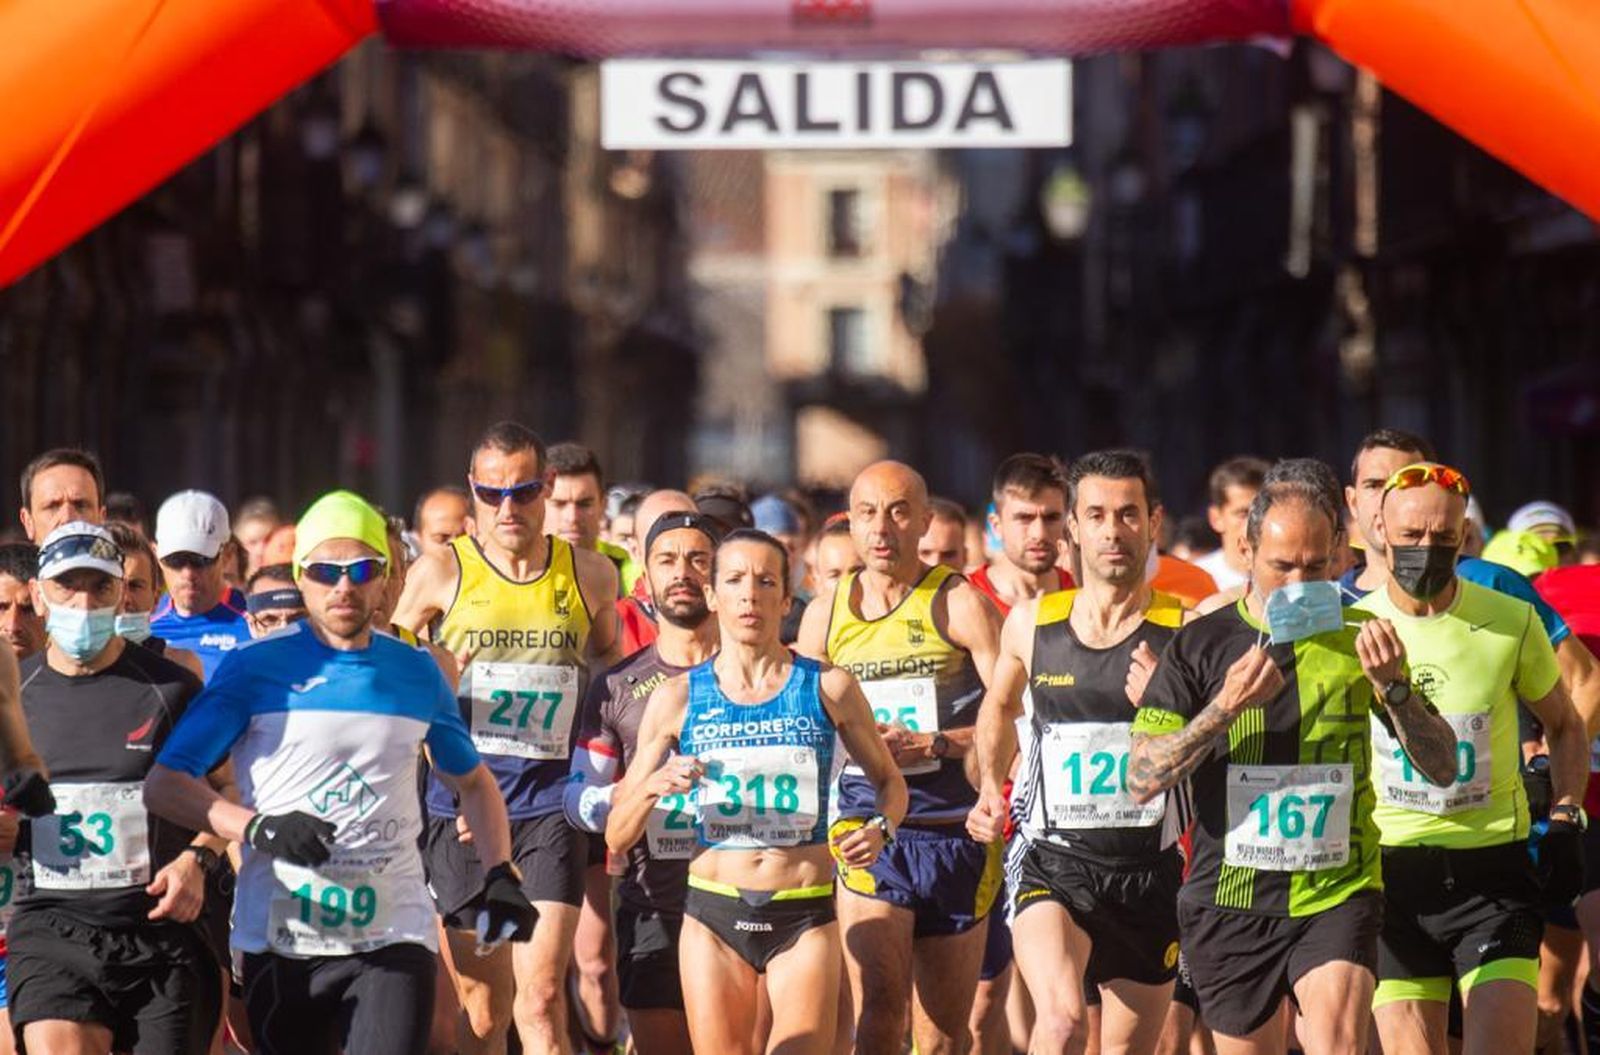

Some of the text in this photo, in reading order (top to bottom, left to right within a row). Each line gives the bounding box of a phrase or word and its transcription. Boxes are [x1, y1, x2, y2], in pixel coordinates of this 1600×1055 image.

[655, 71, 1016, 134] SALIDA
[465, 625, 578, 650] TORREJÓN
[489, 689, 563, 730] 277
[692, 716, 821, 741] CORPOREPOL
[1392, 740, 1476, 783] 10
[717, 774, 800, 817] 318
[1249, 793, 1337, 840] 167
[59, 810, 115, 857] 53
[291, 884, 377, 928] 199
